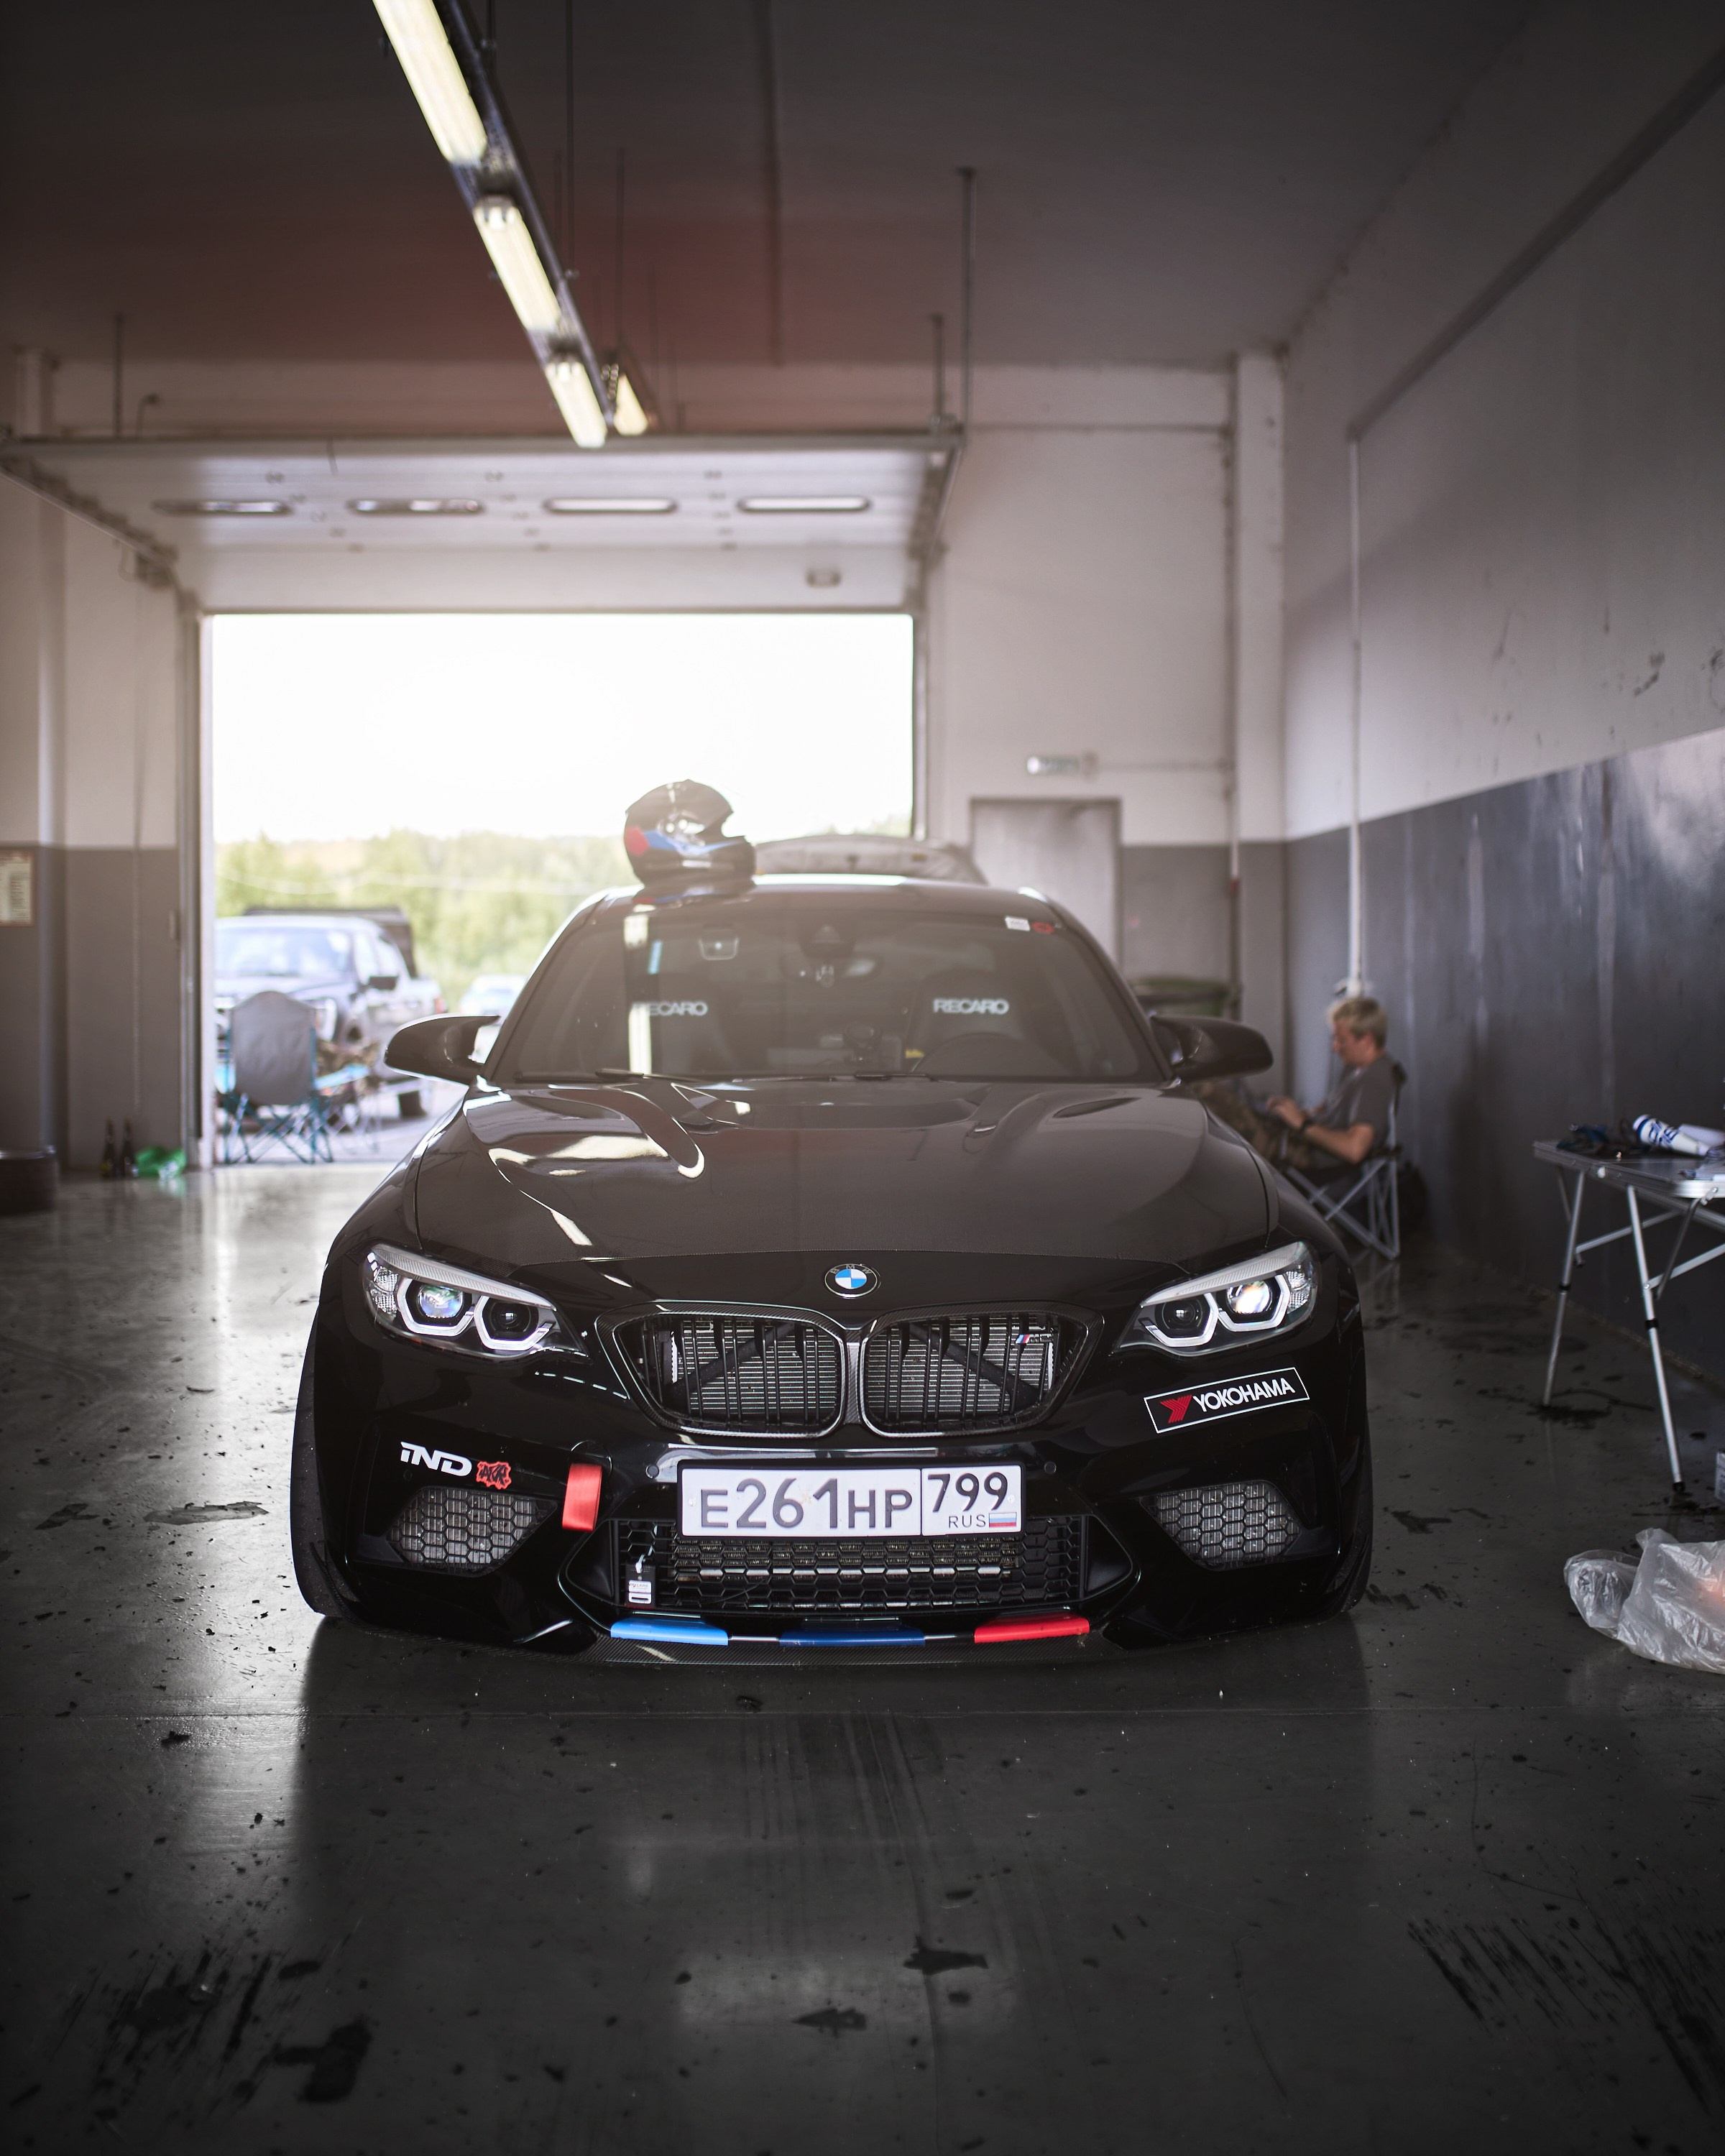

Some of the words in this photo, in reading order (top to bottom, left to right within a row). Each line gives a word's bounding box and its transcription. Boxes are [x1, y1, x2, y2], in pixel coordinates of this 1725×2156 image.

[632, 1001, 708, 1015] ECARO
[933, 999, 1009, 1015] RECARO
[830, 1265, 872, 1274] BMW
[1193, 1378, 1295, 1412] YOKOHAMA
[928, 1472, 1008, 1512] 799
[948, 1514, 986, 1528] RUS
